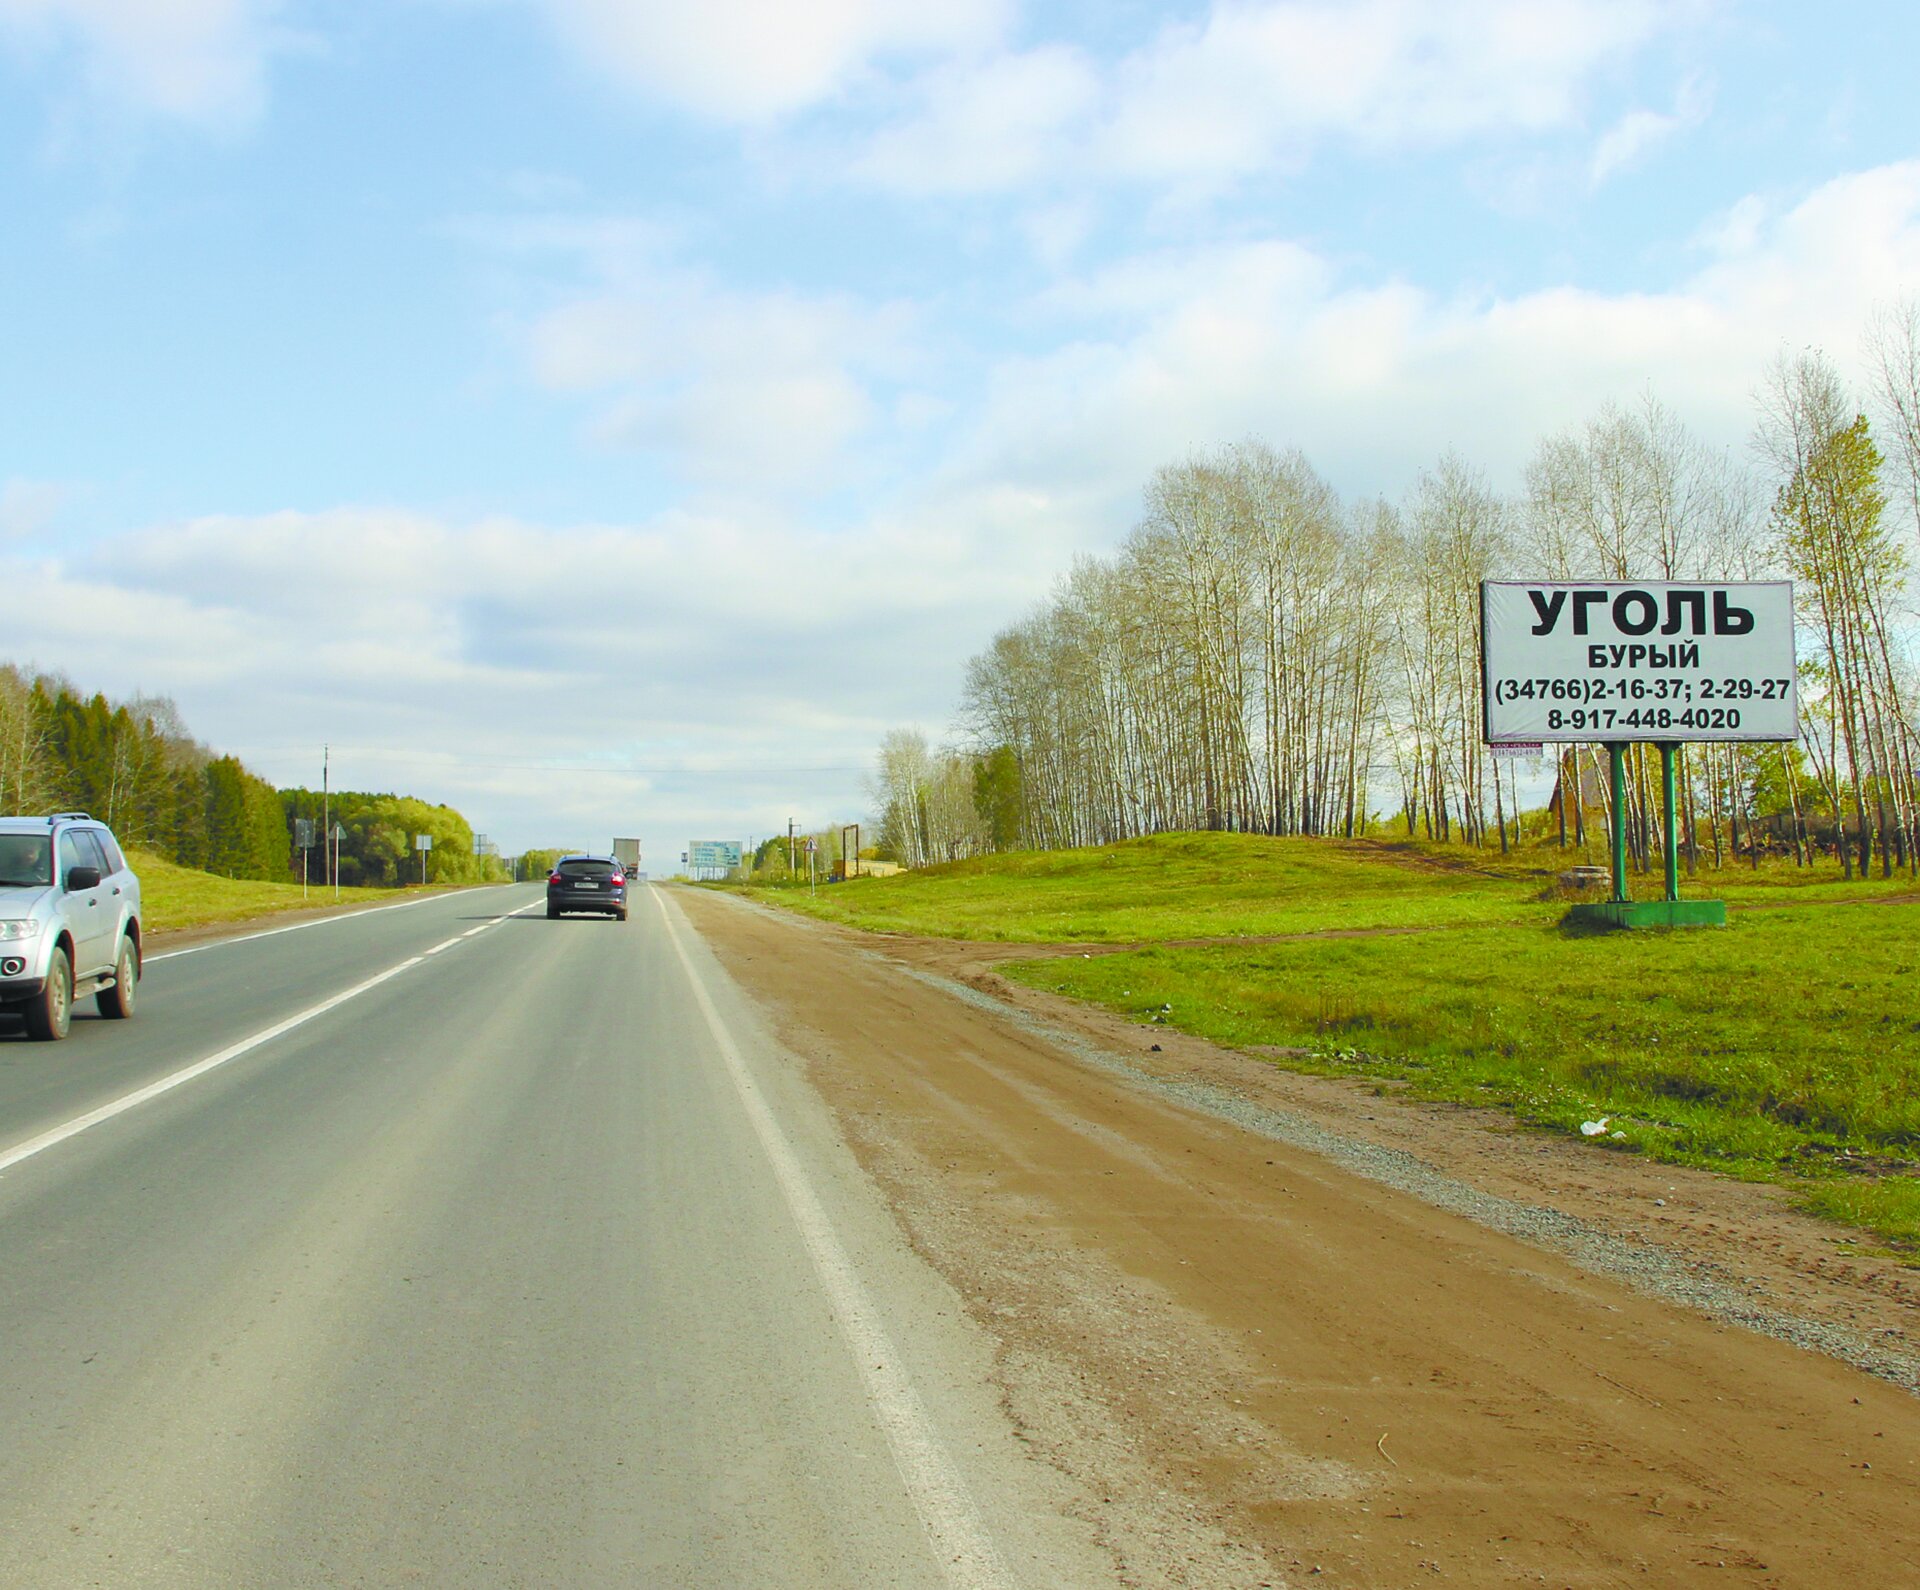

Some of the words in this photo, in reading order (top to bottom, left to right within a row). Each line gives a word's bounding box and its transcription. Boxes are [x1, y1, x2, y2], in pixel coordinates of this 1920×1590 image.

[1528, 590, 1755, 635] УГОЛЬ
[1589, 640, 1700, 668] БУРЫЙ
[1495, 679, 1691, 705] (34766)2-16-37;
[1700, 679, 1790, 700] 2-29-27
[1548, 709, 1740, 729] 8-917-448-4020
